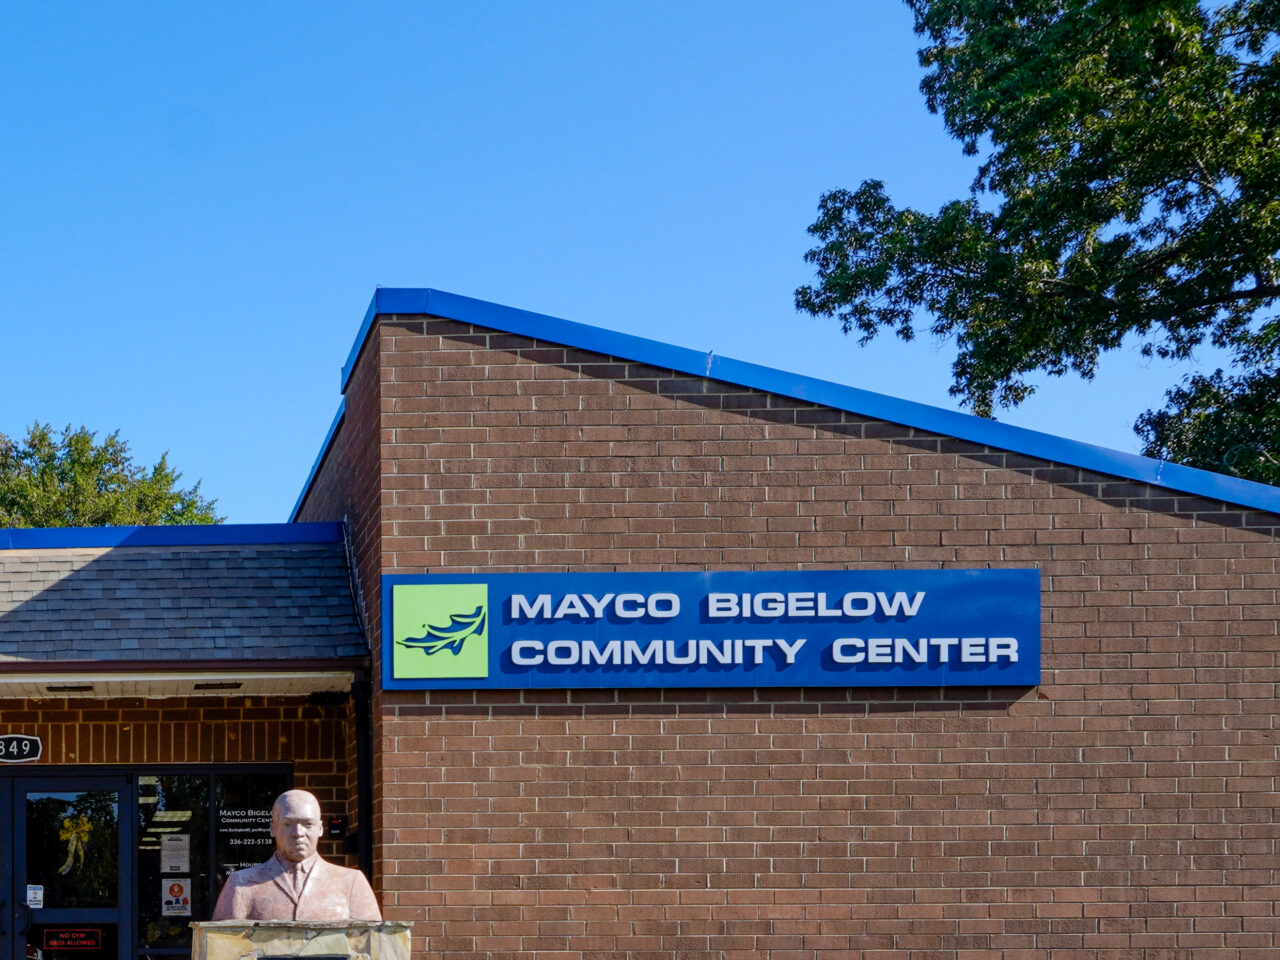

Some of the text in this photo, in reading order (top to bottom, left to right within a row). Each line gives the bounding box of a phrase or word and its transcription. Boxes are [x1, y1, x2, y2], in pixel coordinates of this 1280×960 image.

[509, 591, 926, 620] MAYCO BIGELOW
[510, 637, 1019, 666] COMMUNITY CENTER
